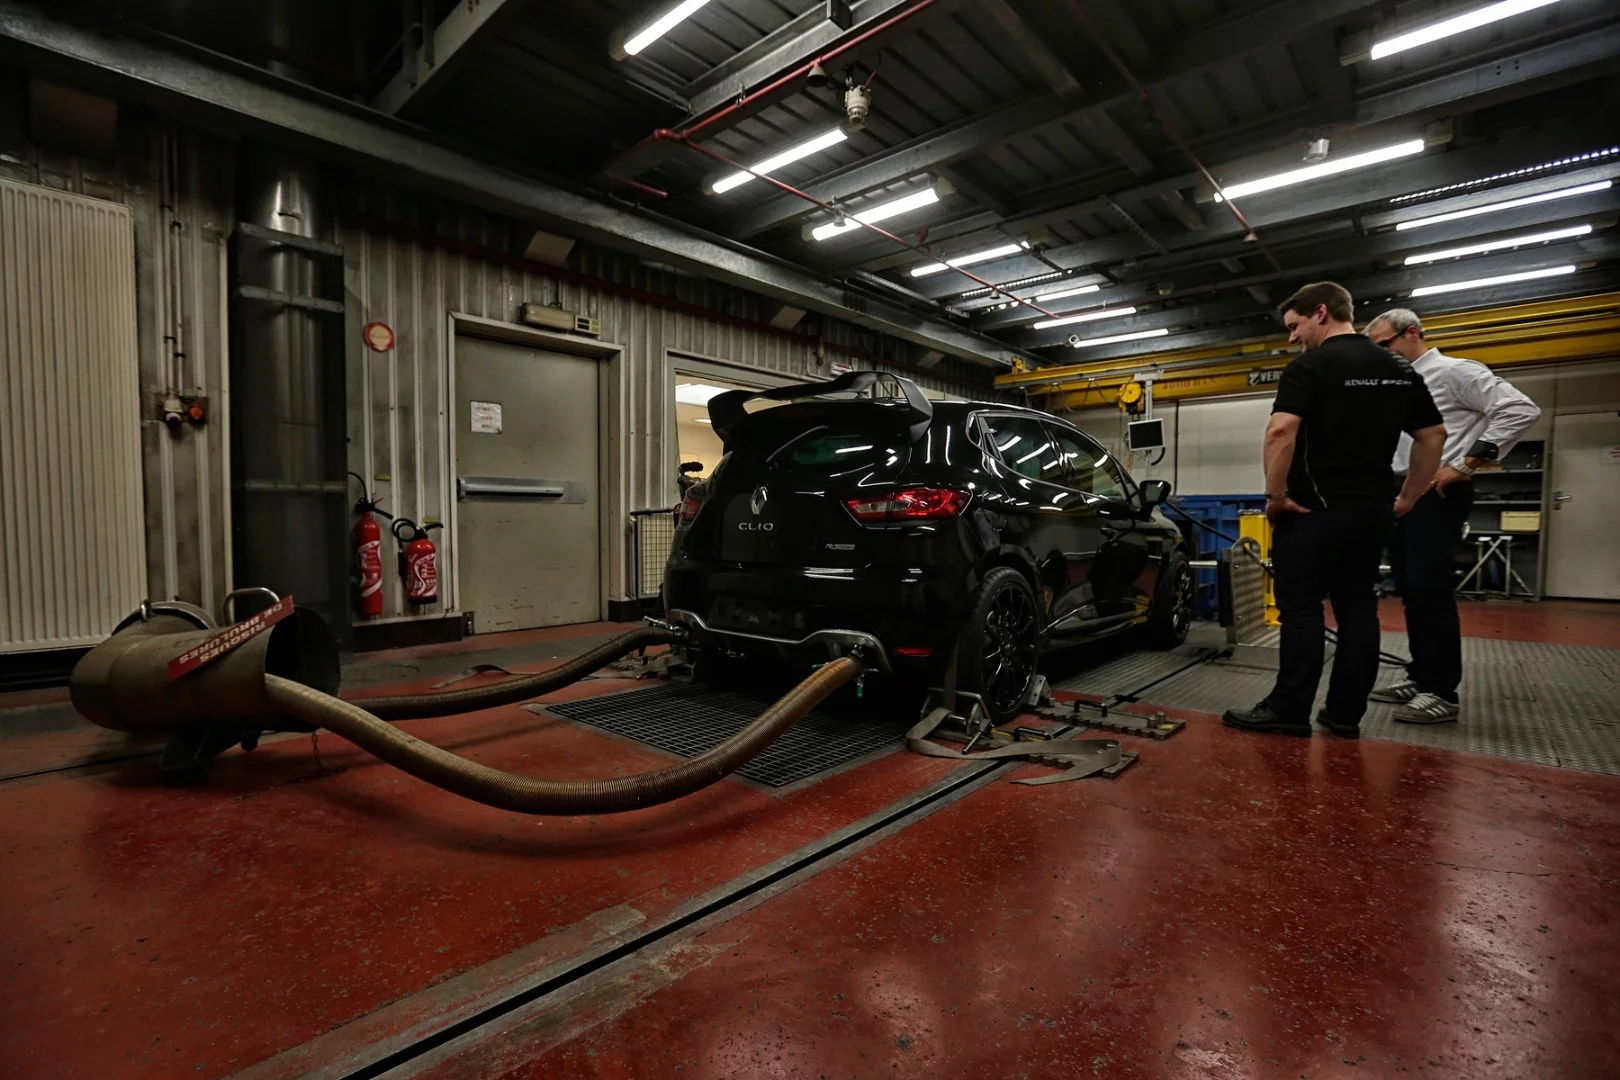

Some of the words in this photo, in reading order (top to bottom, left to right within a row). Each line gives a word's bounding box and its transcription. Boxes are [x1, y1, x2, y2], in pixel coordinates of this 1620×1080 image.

[1344, 378, 1379, 387] RENAULT
[738, 522, 774, 531] CLIO
[263, 603, 283, 618] DE
[179, 616, 260, 664] BRULURES
[199, 621, 266, 662] RISQUES
